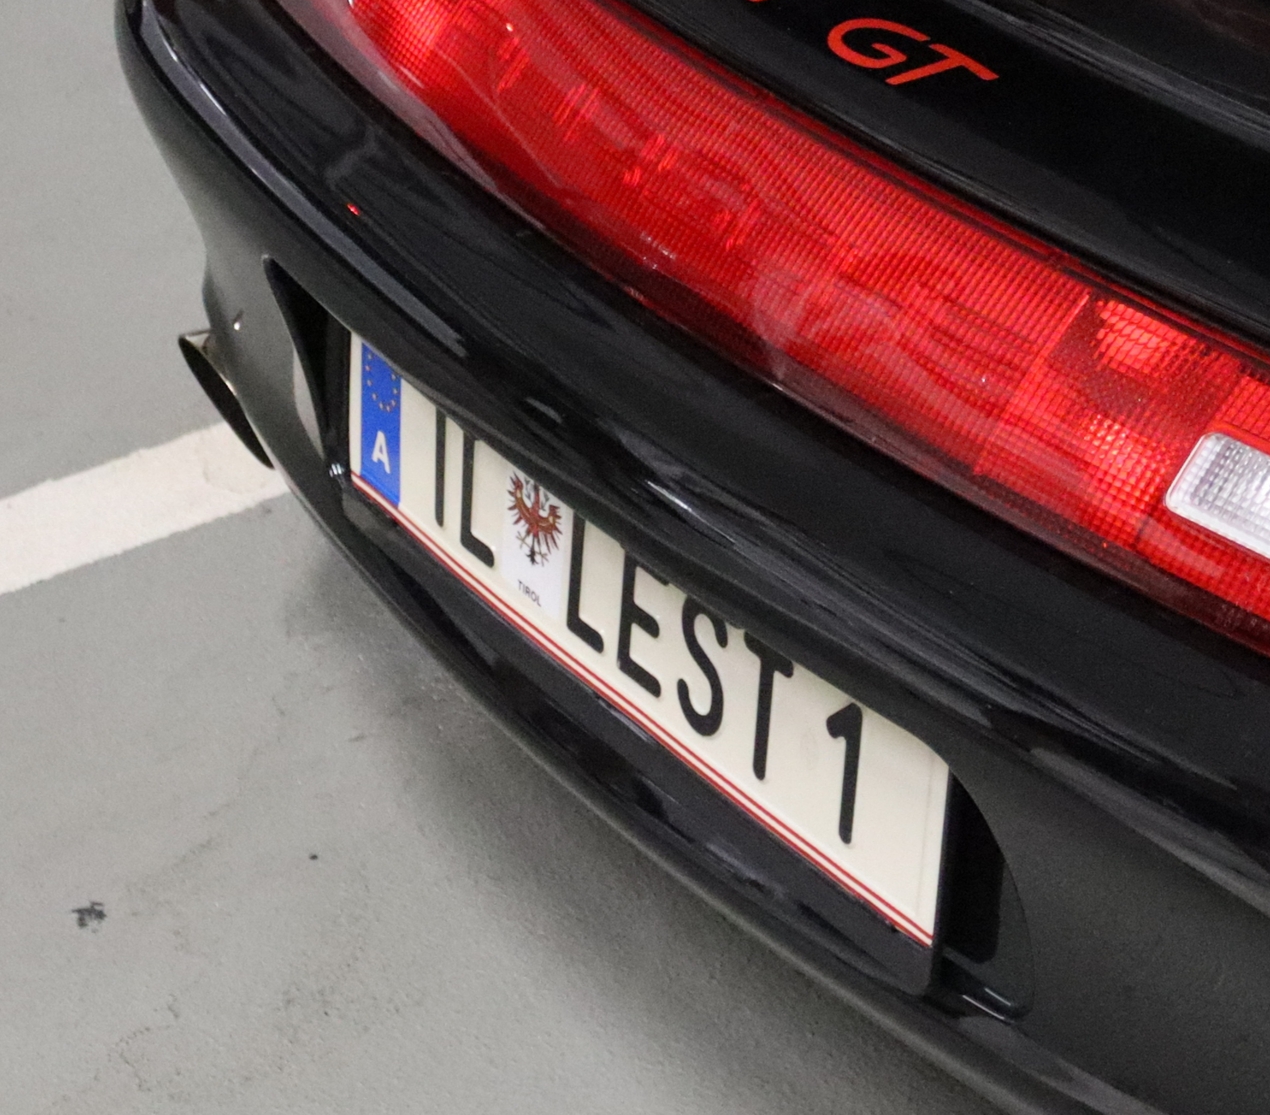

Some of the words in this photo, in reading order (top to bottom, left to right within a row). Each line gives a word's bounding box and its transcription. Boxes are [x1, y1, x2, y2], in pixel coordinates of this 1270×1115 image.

[826, 17, 1000, 86] GT
[371, 430, 391, 475] A
[517, 578, 543, 608] TIROL
[434, 405, 496, 569] IL
[565, 508, 795, 782] LEST
[825, 701, 864, 846] 1
